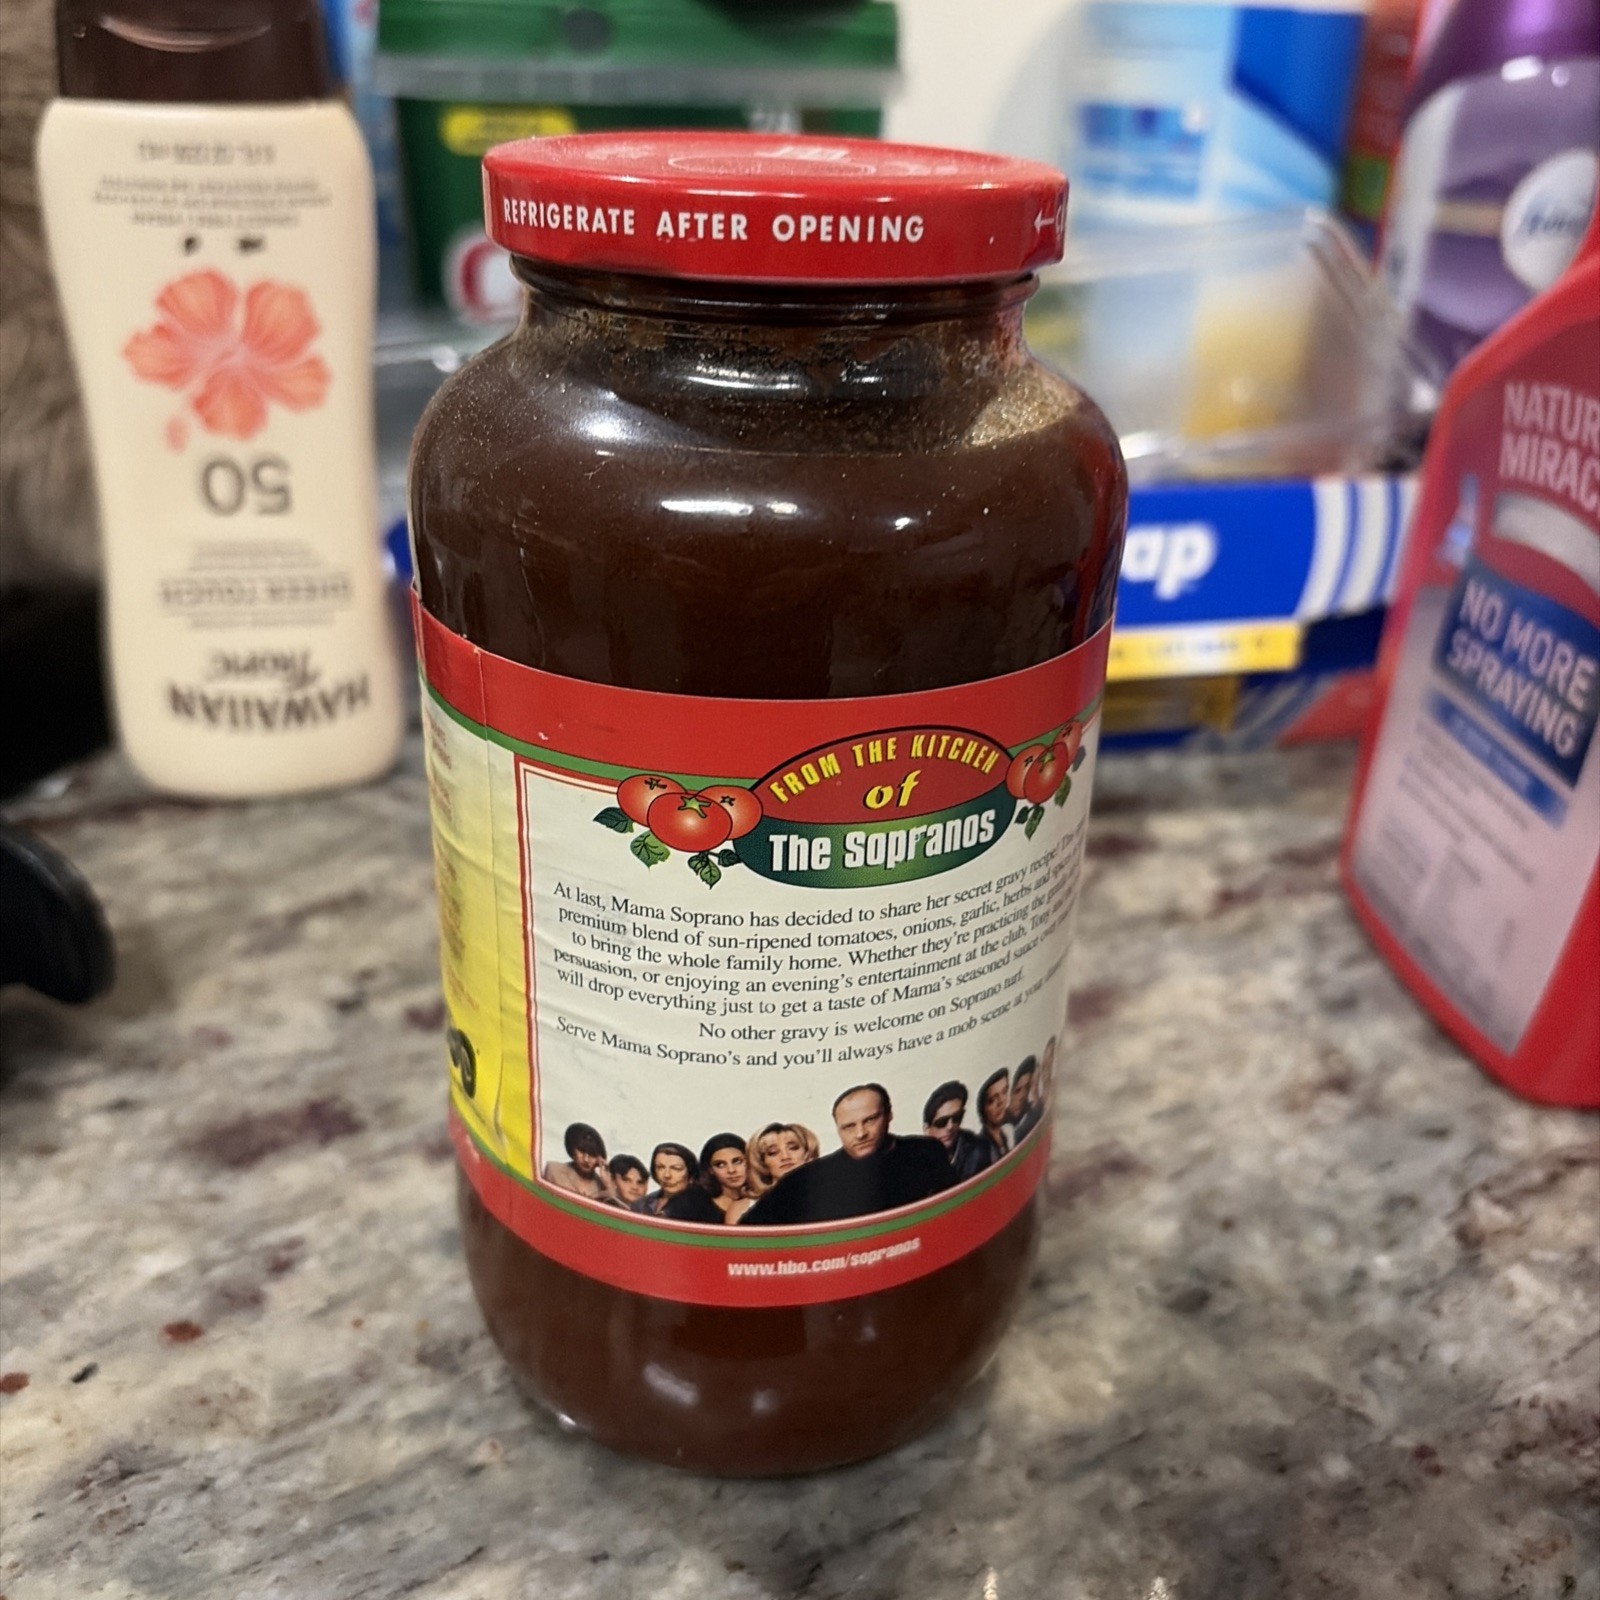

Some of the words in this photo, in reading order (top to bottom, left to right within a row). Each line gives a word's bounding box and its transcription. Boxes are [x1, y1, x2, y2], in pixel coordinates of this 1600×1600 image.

[503, 198, 635, 236] REFRIGERATE
[656, 211, 748, 240] AFTER
[772, 214, 924, 243] OPENING
[1503, 382, 1600, 451] NATUR
[200, 458, 293, 518] 50
[1500, 433, 1600, 512] MIRAC
[1459, 577, 1504, 641] NO
[1502, 610, 1597, 711] MORE
[166, 676, 371, 735] HAWAIIAN
[1448, 629, 1578, 757] SPRAYING
[770, 753, 841, 803] FROM
[852, 737, 897, 767] THE
[911, 734, 999, 774] KITCHEN
[864, 770, 922, 809] of
[769, 834, 832, 872] The
[844, 809, 996, 869] Sopranos
[553, 881, 572, 899] At
[576, 887, 606, 911] last,
[611, 895, 665, 919] Mama
[670, 906, 744, 928] Soprano
[749, 912, 779, 927] has
[785, 908, 852, 926] decided
[858, 909, 875, 922] to
[880, 903, 922, 919] share
[926, 894, 951, 911] her
[954, 880, 992, 903] secret
[995, 866, 1028, 894] gravy
[559, 906, 627, 935] premium
[632, 922, 679, 943] blend
[684, 931, 703, 946] of
[708, 933, 811, 953] sun-ripened
[818, 929, 897, 947] tomatoes,
[903, 914, 956, 937] onions,
[960, 900, 1000, 926] garlic,
[1003, 882, 1032, 907] herbs
[554, 948, 637, 982] persuasion,
[643, 970, 660, 983] or
[665, 973, 739, 995] enjoying
[746, 979, 766, 992] an
[858, 956, 961, 985] entertainment
[965, 948, 977, 963] at
[980, 941, 999, 956] the
[572, 931, 586, 945] to
[591, 934, 632, 961] bring
[637, 944, 662, 963] the
[668, 951, 720, 969] whole
[727, 955, 783, 974] family
[789, 954, 842, 970] home.
[848, 946, 918, 965] Whether
[973, 905, 1029, 943] practicing
[557, 969, 584, 989] will
[588, 976, 624, 1001] drop
[628, 989, 716, 1015] everything
[720, 997, 752, 1016] just
[759, 998, 776, 1013] to
[781, 999, 807, 1017] get
[813, 999, 823, 1012] a
[828, 993, 865, 1011] taste
[870, 990, 889, 1005] of
[955, 950, 1010, 985] seasoned
[699, 1023, 726, 1038] No
[731, 1026, 776, 1040] other
[781, 1025, 829, 1043] gravy
[834, 1021, 848, 1036] is
[854, 1011, 924, 1033] welcome
[928, 1005, 946, 1019] on
[950, 982, 1002, 1012] Soprano
[557, 1016, 597, 1042] Serve
[601, 1031, 652, 1056] Mama
[746, 1051, 778, 1066] and
[838, 1041, 893, 1062] always
[897, 1034, 932, 1052] have
[936, 1029, 944, 1042] a
[948, 1016, 978, 1037] mob
[980, 1001, 1012, 1025] scene
[727, 1237, 921, 1276] www.hbo.com/sopranos
